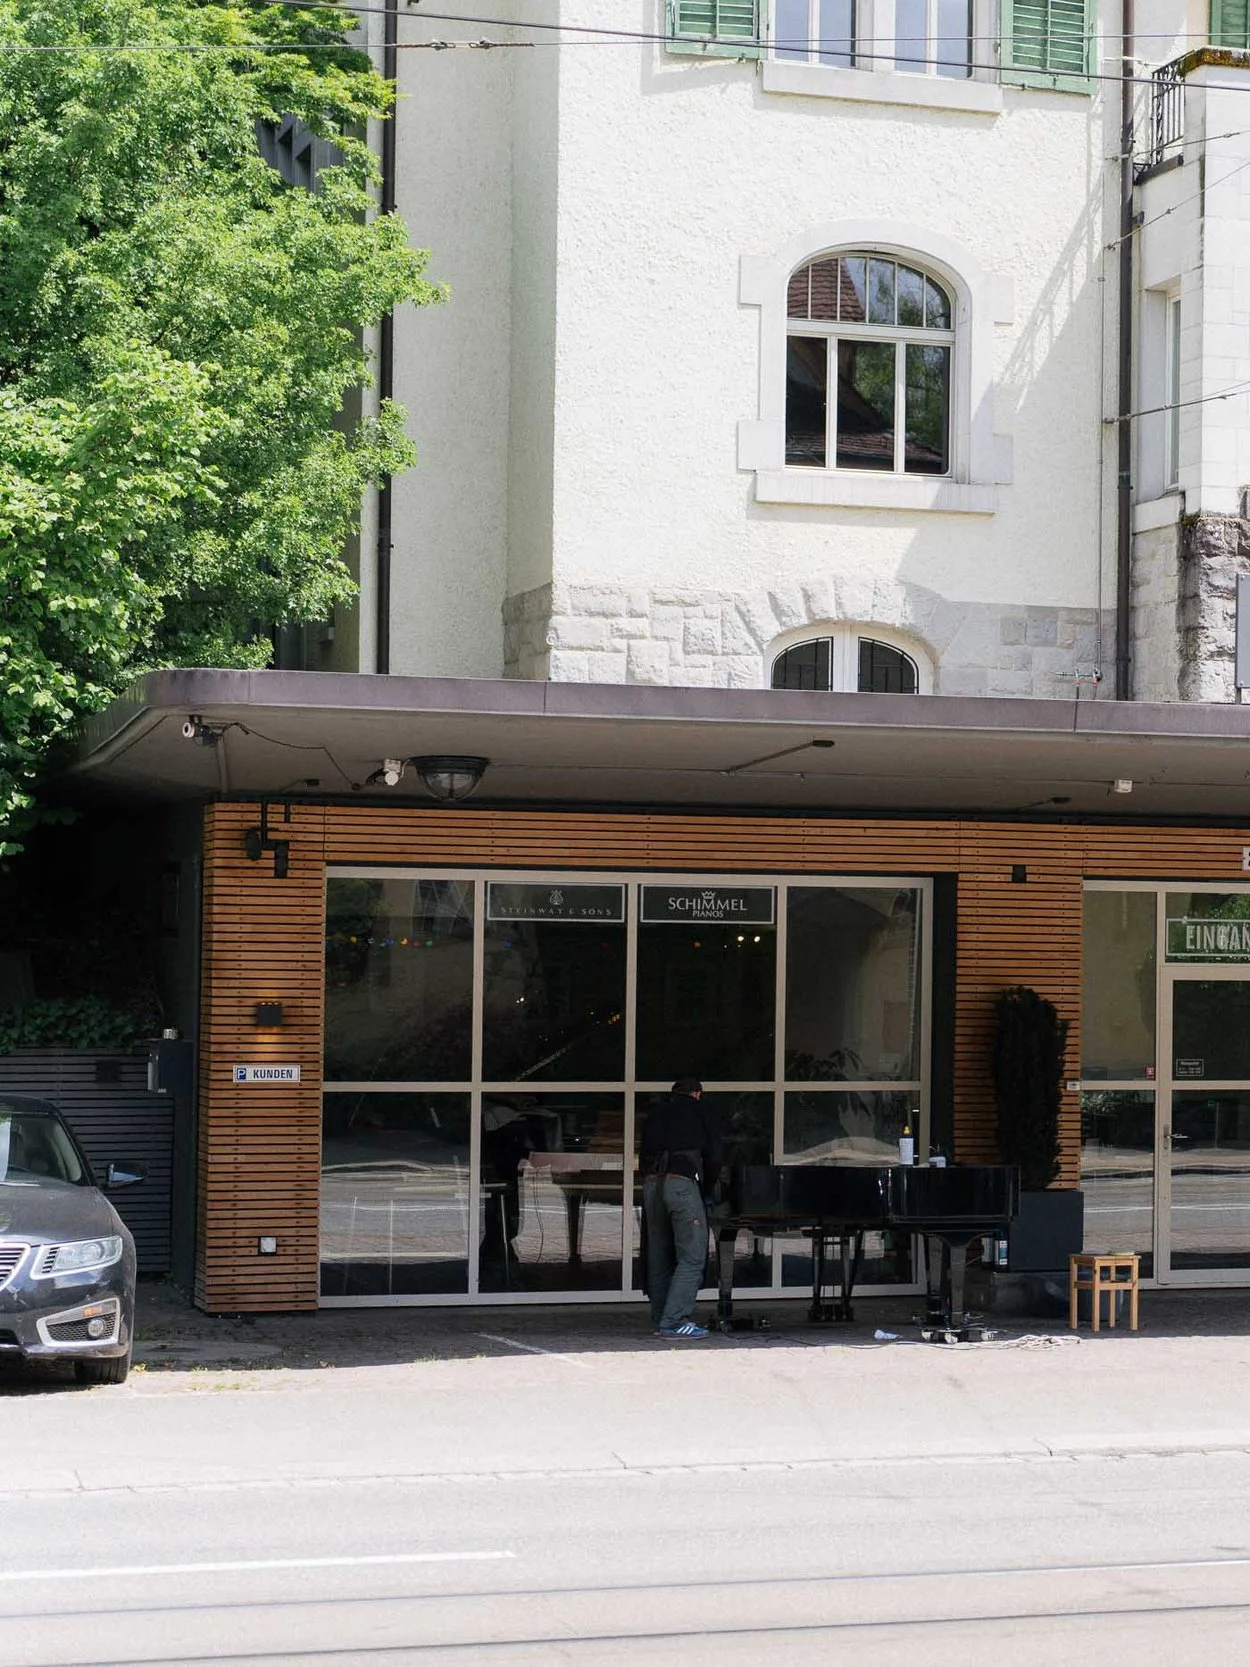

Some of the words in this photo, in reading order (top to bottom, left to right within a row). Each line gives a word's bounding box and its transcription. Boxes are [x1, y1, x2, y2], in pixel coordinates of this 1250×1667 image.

[668, 897, 748, 911] SCHIMMEL
[501, 906, 563, 915] STEINWAY
[581, 907, 613, 917] SONS
[693, 909, 724, 918] PIANOS
[237, 1069, 246, 1079] P
[253, 1069, 293, 1079] KUNDEN
